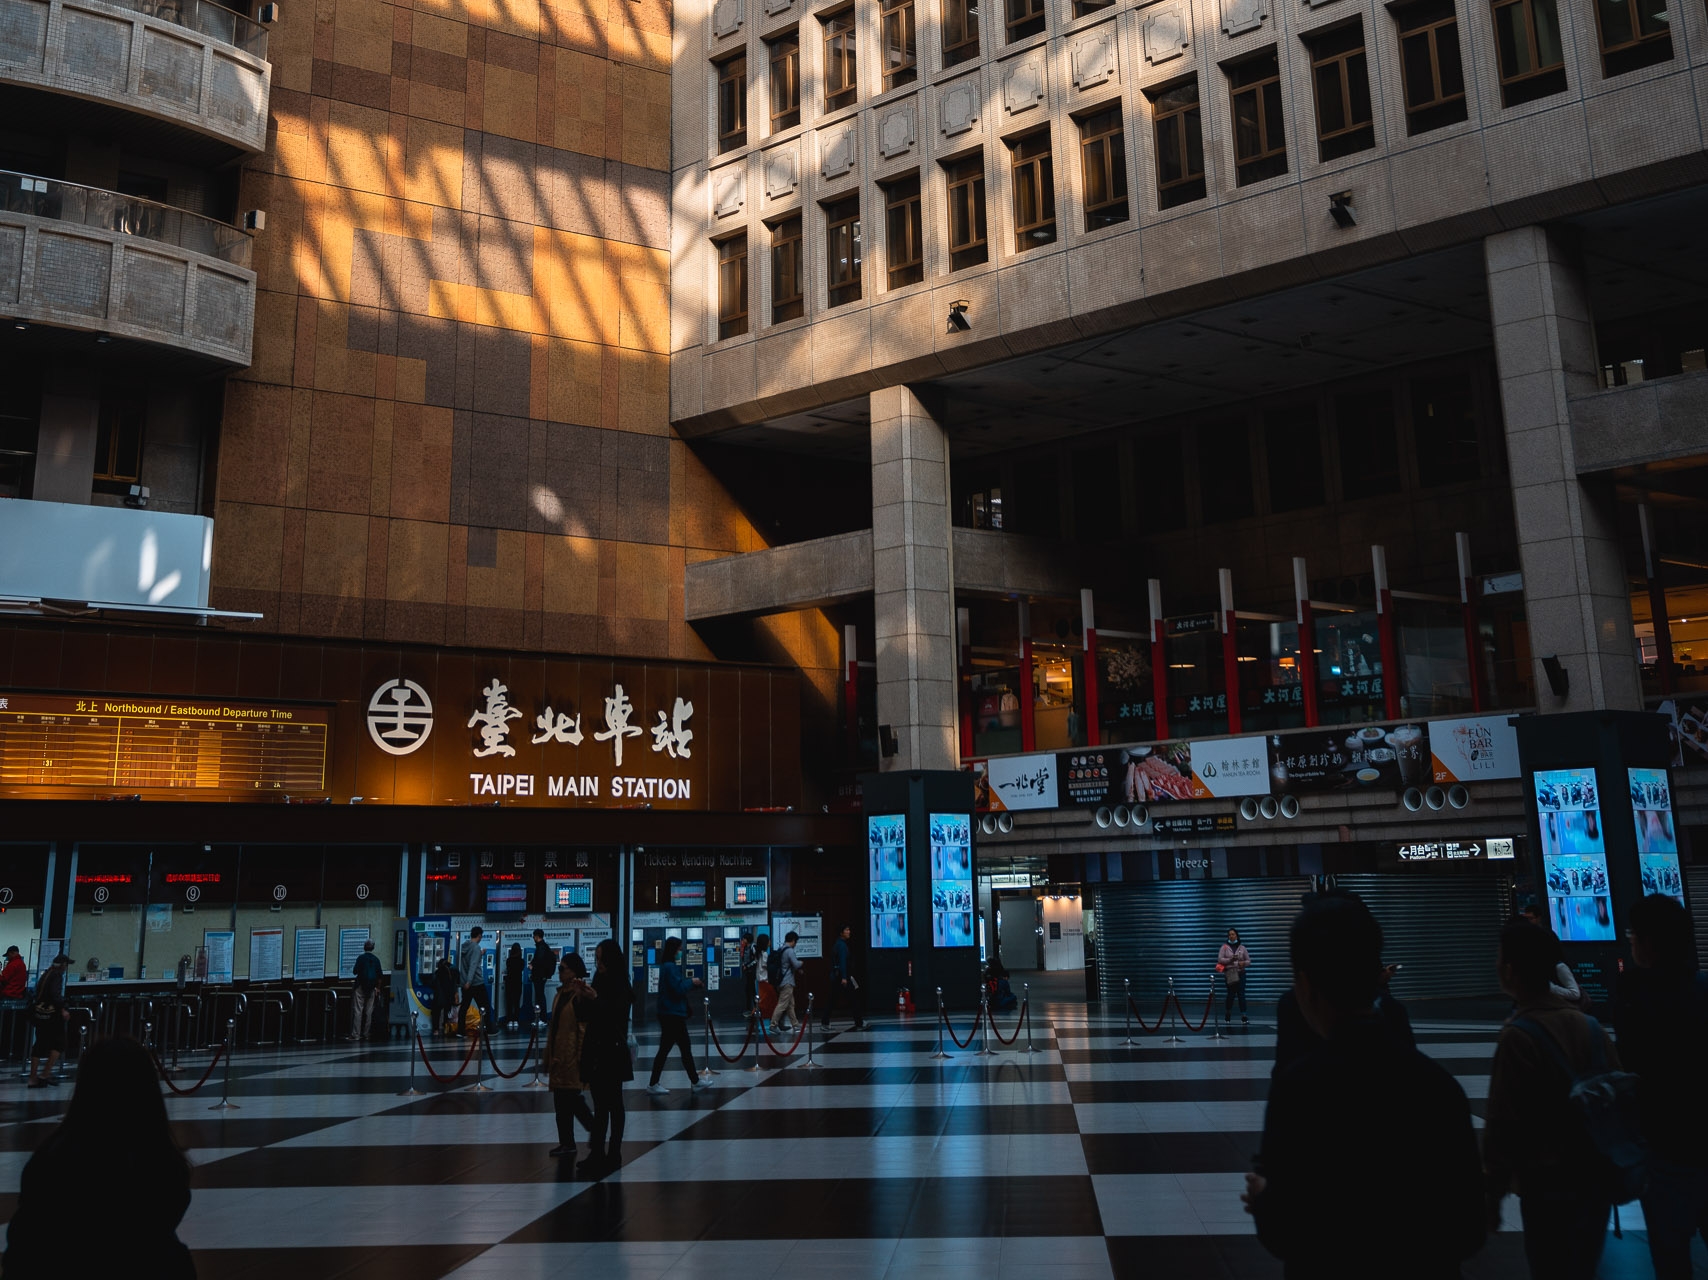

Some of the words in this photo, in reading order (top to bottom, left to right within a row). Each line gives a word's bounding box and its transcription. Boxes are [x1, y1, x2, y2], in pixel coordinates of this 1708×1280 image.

[1341, 678, 1383, 696] 大河屋
[1263, 687, 1302, 704] 大河屋
[76, 700, 98, 713] 北上
[1189, 694, 1226, 712] 大河屋
[104, 703, 162, 714] Northbound
[170, 705, 221, 717] Eastbound
[223, 707, 268, 719] Departure
[270, 709, 293, 719] Time
[1119, 702, 1154, 718] 大河屋
[468, 678, 694, 767] 臺北車站
[1468, 727, 1491, 738] FUN
[1470, 738, 1493, 749] BAR
[1473, 762, 1495, 770] LILI
[1435, 772, 1447, 780] 2F
[469, 773, 535, 796] TAIPEI
[547, 775, 599, 797] MAIN
[611, 776, 691, 799] STATION
[1195, 788, 1205, 796] 2F
[990, 801, 1000, 810] 2F
[1409, 844, 1425, 856] 月台
[448, 851, 589, 868] 自動售票機
[643, 854, 677, 866] Tickets
[681, 855, 715, 867] Vending
[719, 854, 753, 866] Machine
[1175, 858, 1209, 869] Breeze
